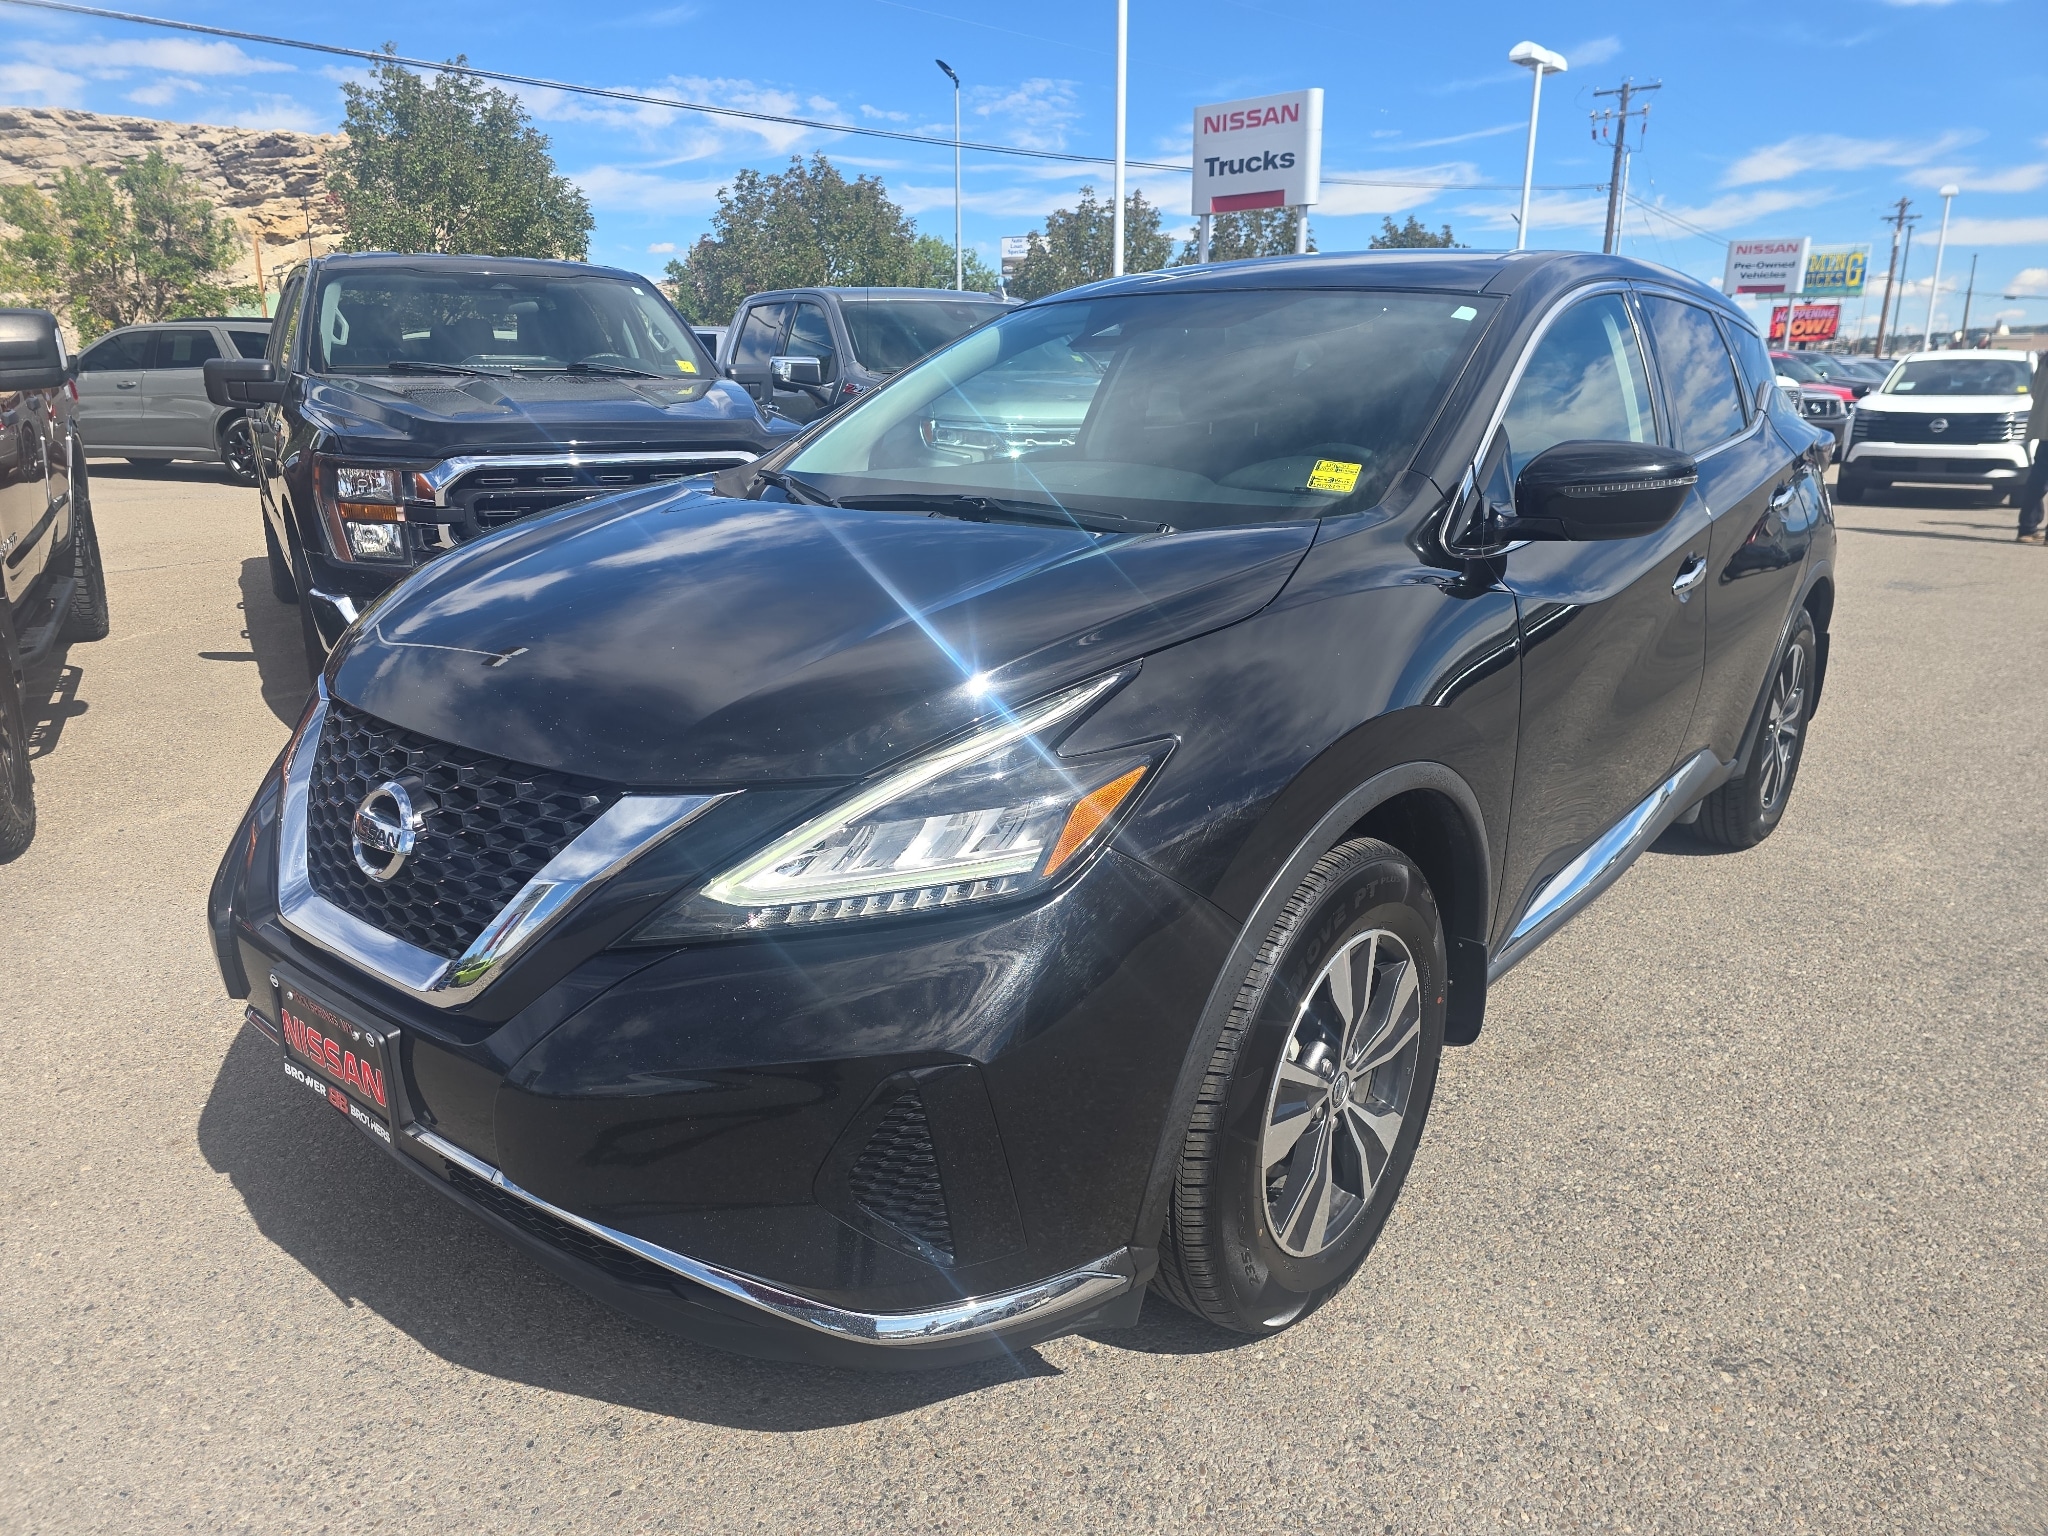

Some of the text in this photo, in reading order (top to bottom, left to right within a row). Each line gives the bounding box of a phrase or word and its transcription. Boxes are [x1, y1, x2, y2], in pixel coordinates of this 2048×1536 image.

[1203, 103, 1299, 135] NISSAN
[1204, 150, 1295, 177] Trucks
[1736, 243, 1799, 255] NISSAN
[1733, 261, 1796, 269] Pre-Owned
[1739, 271, 1787, 279] Vehicles
[1776, 309, 1836, 322] HPPENING
[281, 1007, 388, 1108] NISSAN
[284, 1063, 327, 1097] BROWER
[350, 1104, 392, 1144] BROTHERS
